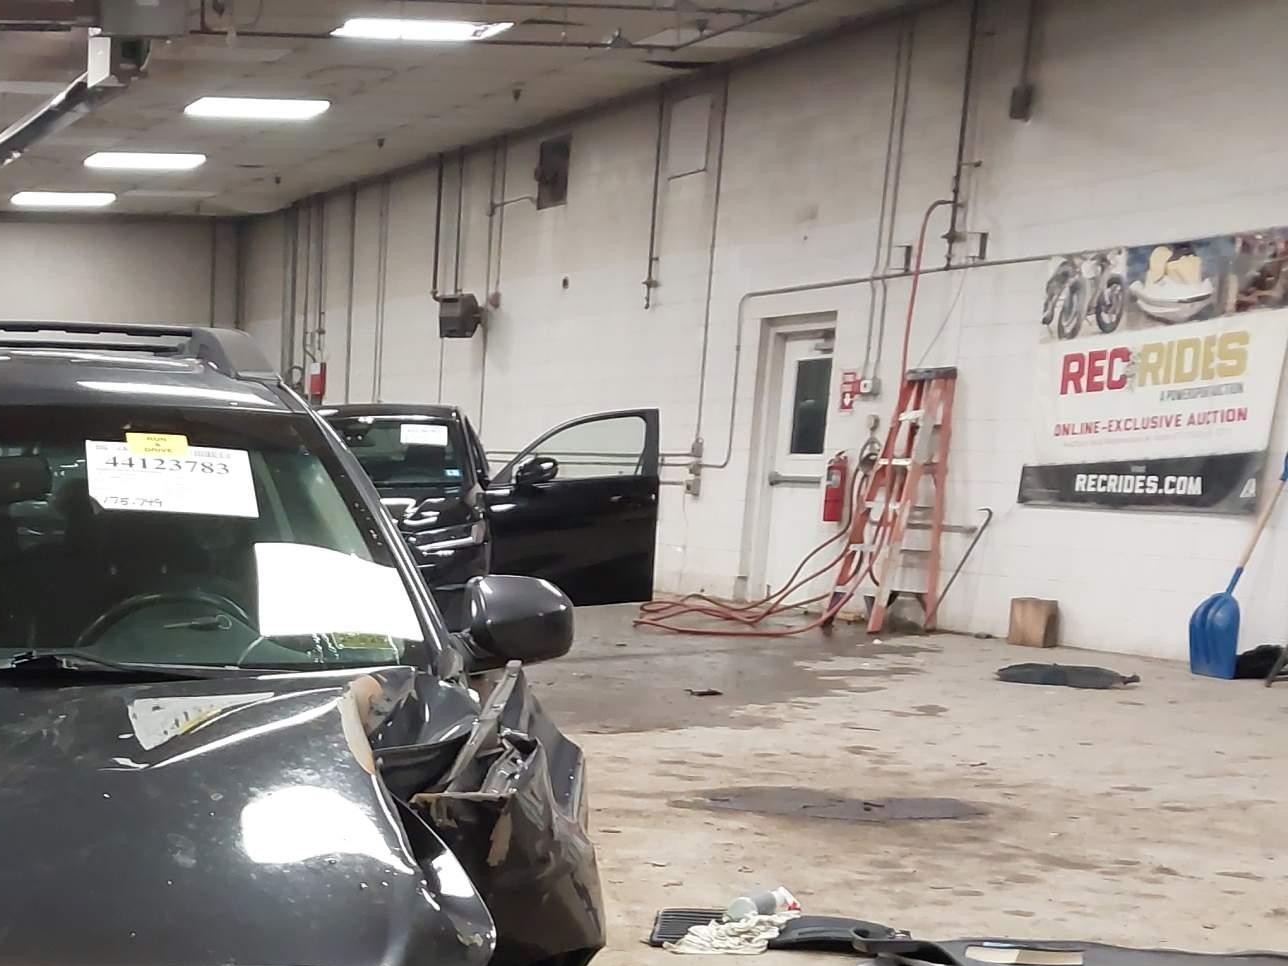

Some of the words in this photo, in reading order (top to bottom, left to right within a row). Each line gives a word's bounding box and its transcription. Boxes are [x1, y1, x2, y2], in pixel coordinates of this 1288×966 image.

[1060, 346, 1132, 395] REC
[1137, 331, 1250, 387] RIDES
[1053, 413, 1182, 437] ONLINE-EXCLUSIVE
[1187, 407, 1249, 426] AUCTION
[105, 456, 230, 476] 44123783
[1075, 474, 1203, 496] RECRIDES.COM
